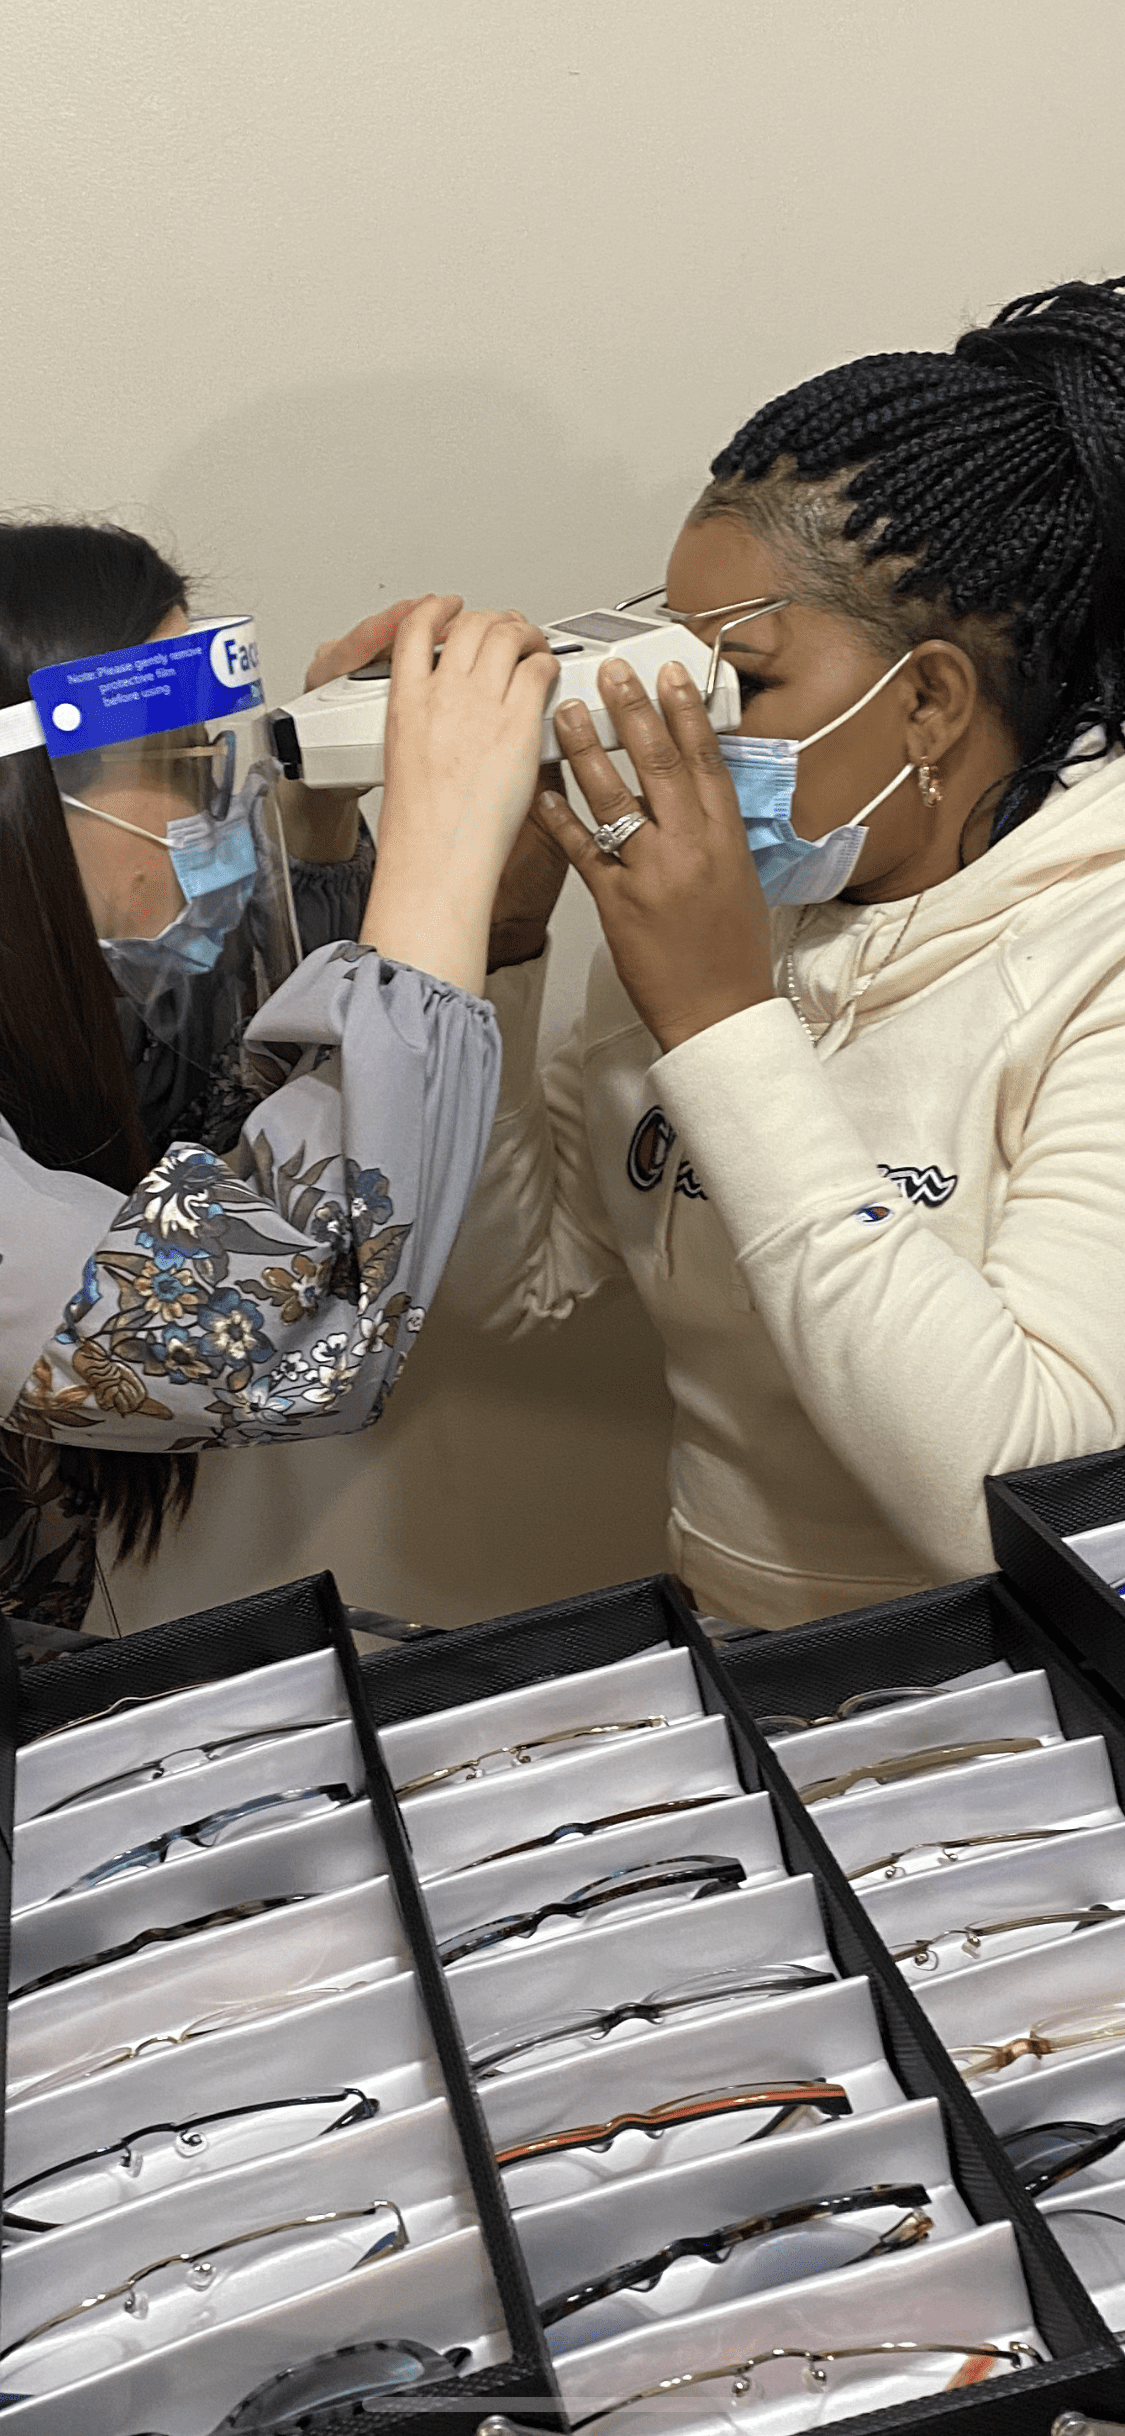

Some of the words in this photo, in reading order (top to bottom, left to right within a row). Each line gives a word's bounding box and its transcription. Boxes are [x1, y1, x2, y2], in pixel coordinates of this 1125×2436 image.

[135, 653, 168, 672] gently
[169, 647, 202, 660] remove
[99, 673, 155, 695] protective
[155, 667, 176, 678] film
[102, 691, 140, 707] before
[141, 684, 171, 698] using
